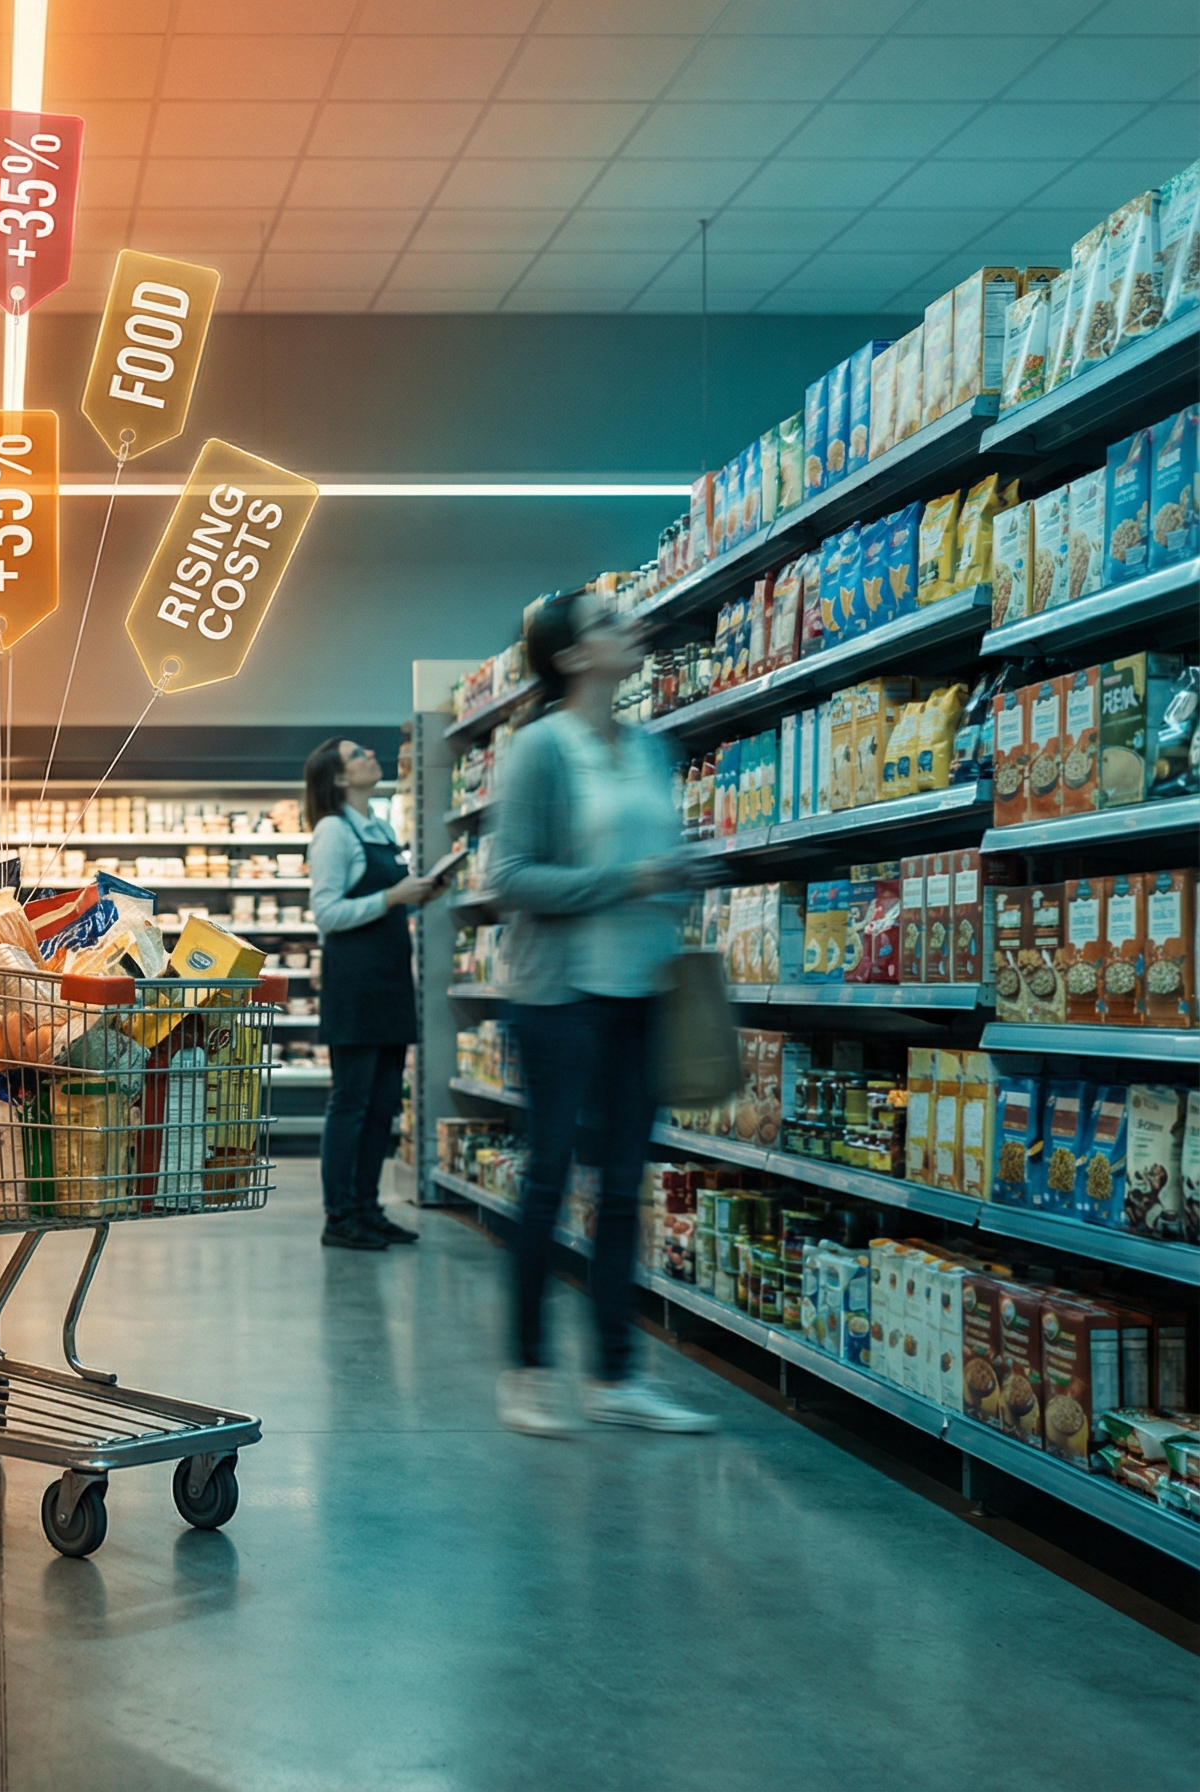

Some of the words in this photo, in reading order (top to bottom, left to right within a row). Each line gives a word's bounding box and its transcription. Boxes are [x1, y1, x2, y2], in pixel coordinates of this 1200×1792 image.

[110, 282, 190, 409] FOOD
[157, 484, 247, 629] RISING
[198, 500, 282, 640] COSTS
